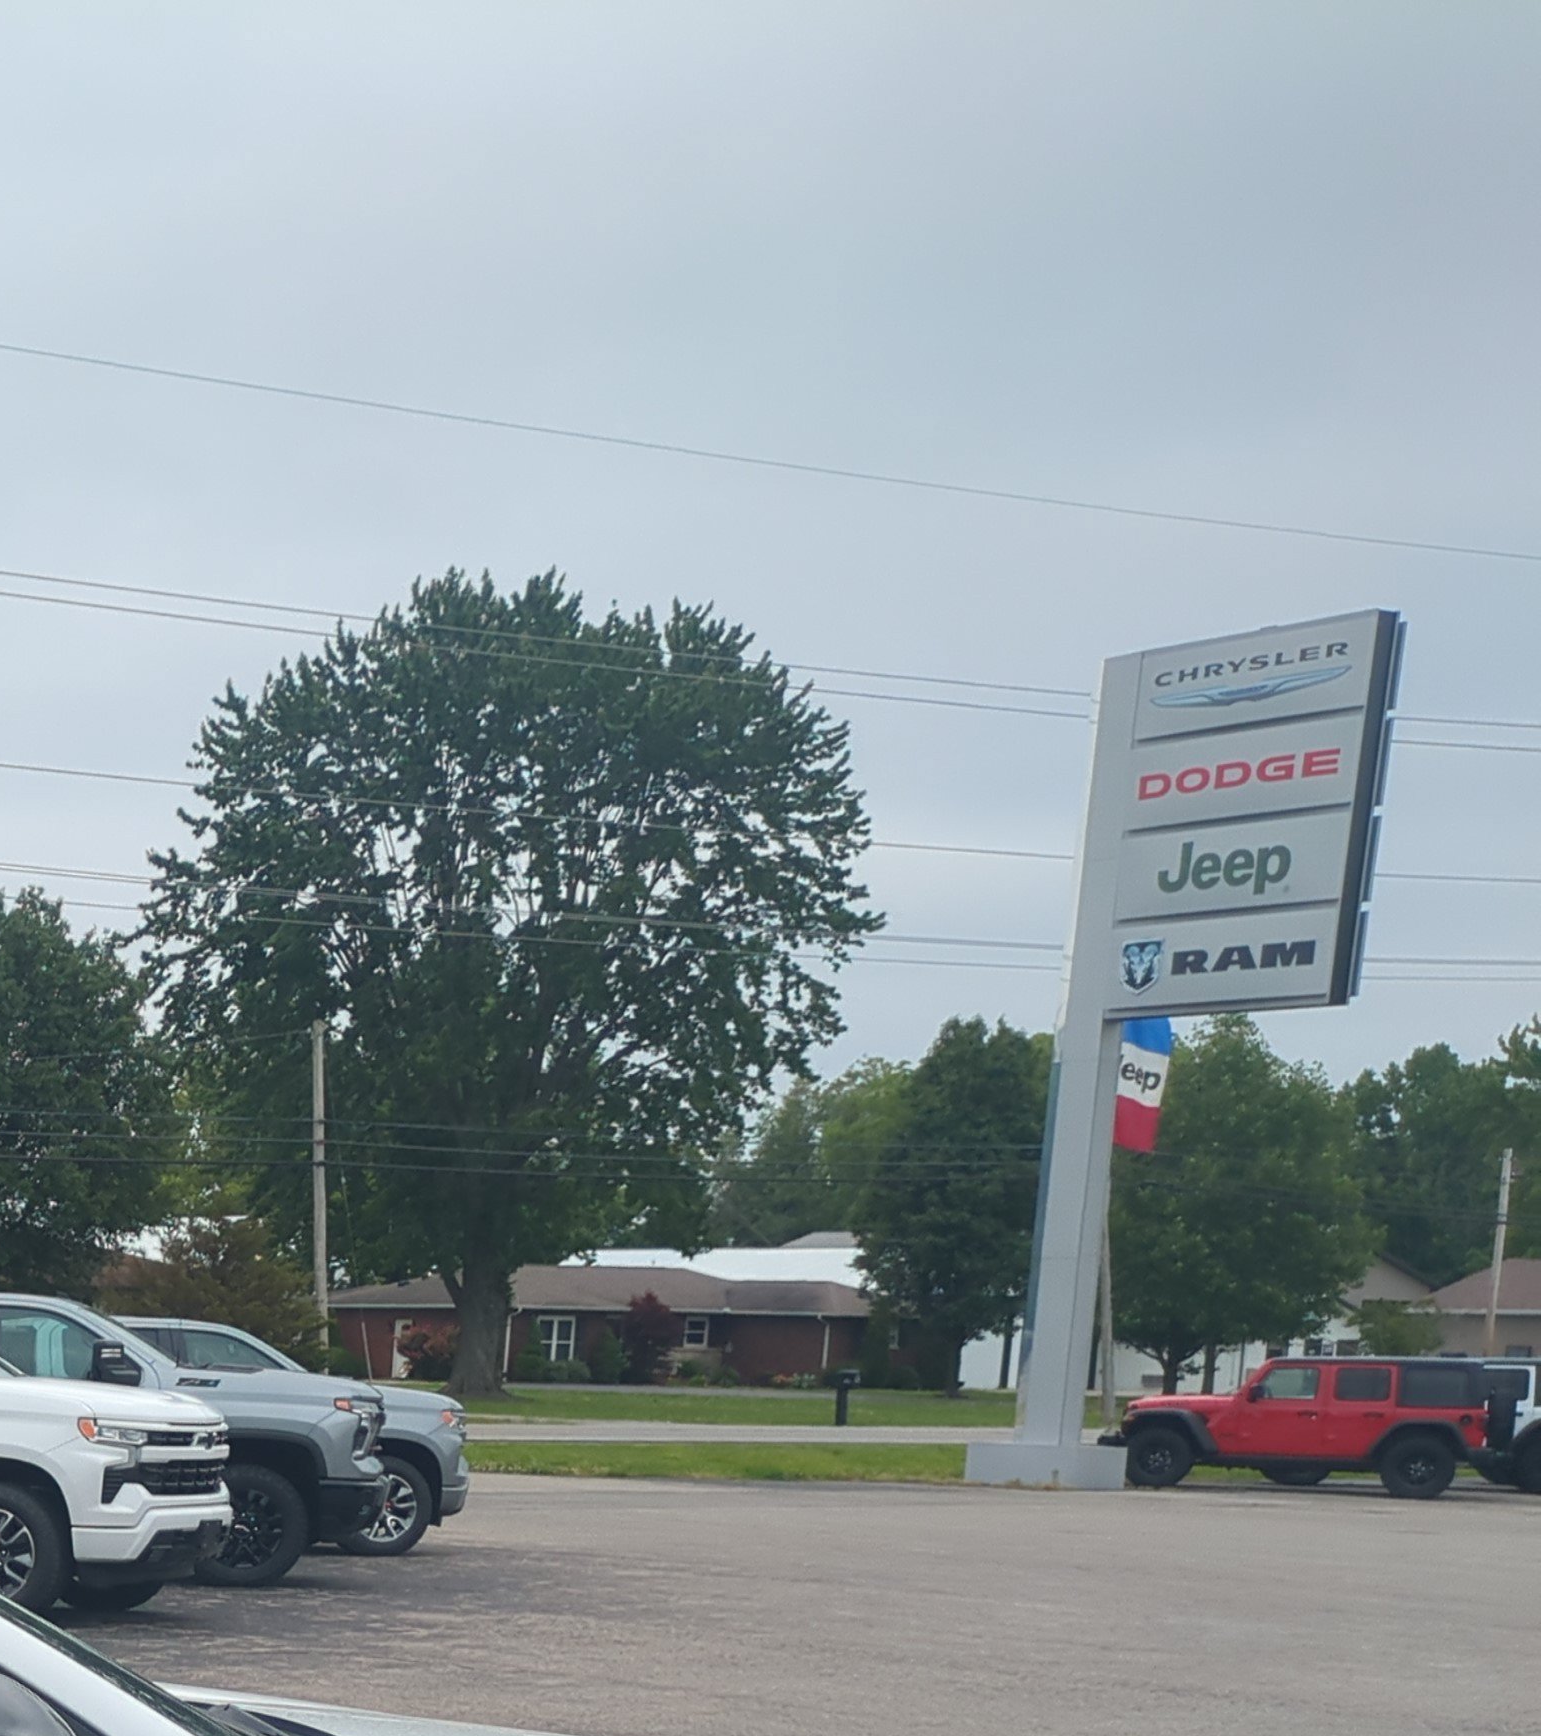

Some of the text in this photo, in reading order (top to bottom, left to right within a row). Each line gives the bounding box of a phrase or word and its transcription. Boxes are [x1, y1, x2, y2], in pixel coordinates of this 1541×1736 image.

[1154, 641, 1349, 688] CHRYSLER
[1137, 748, 1341, 800] DODGE
[1157, 841, 1292, 896] Jeep
[1170, 939, 1316, 976] RAM
[1119, 1058, 1162, 1094] eep
